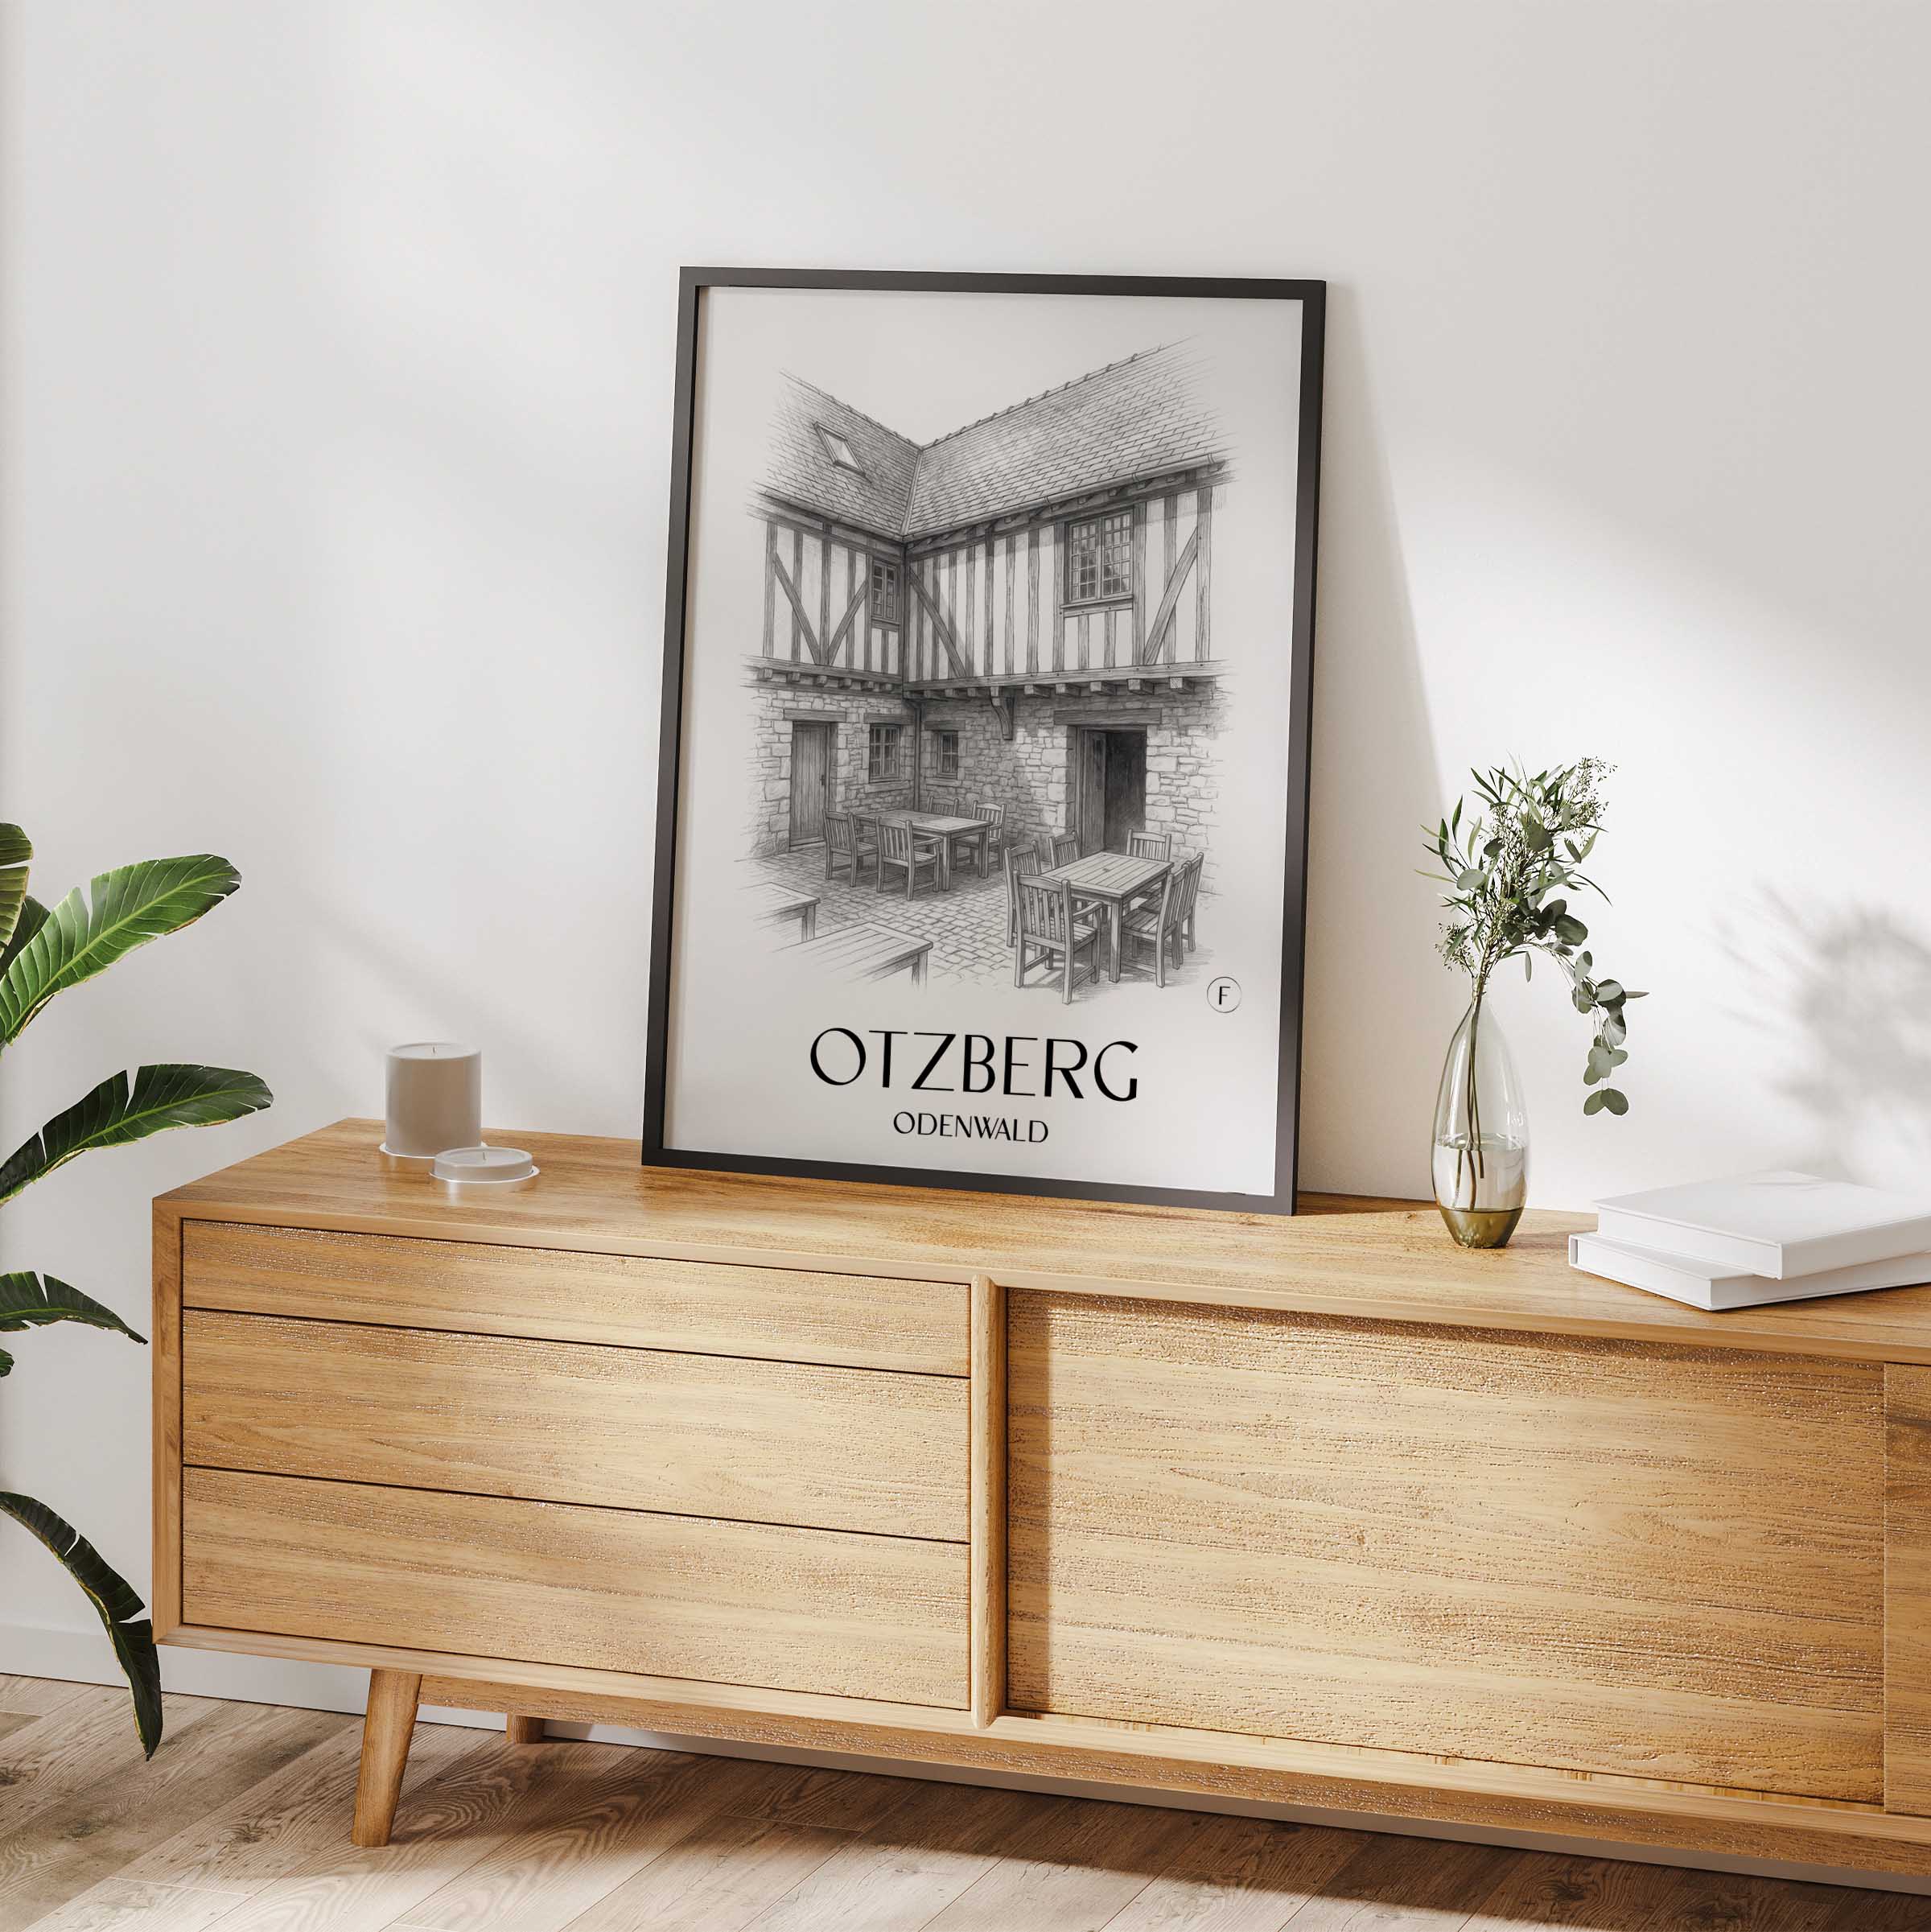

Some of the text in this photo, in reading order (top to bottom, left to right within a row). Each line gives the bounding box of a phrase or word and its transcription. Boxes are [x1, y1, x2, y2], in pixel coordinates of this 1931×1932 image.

[1218, 986, 1231, 1005] F
[809, 1028, 1138, 1102] OTZBERG
[893, 1111, 1049, 1143] ODENWALD
